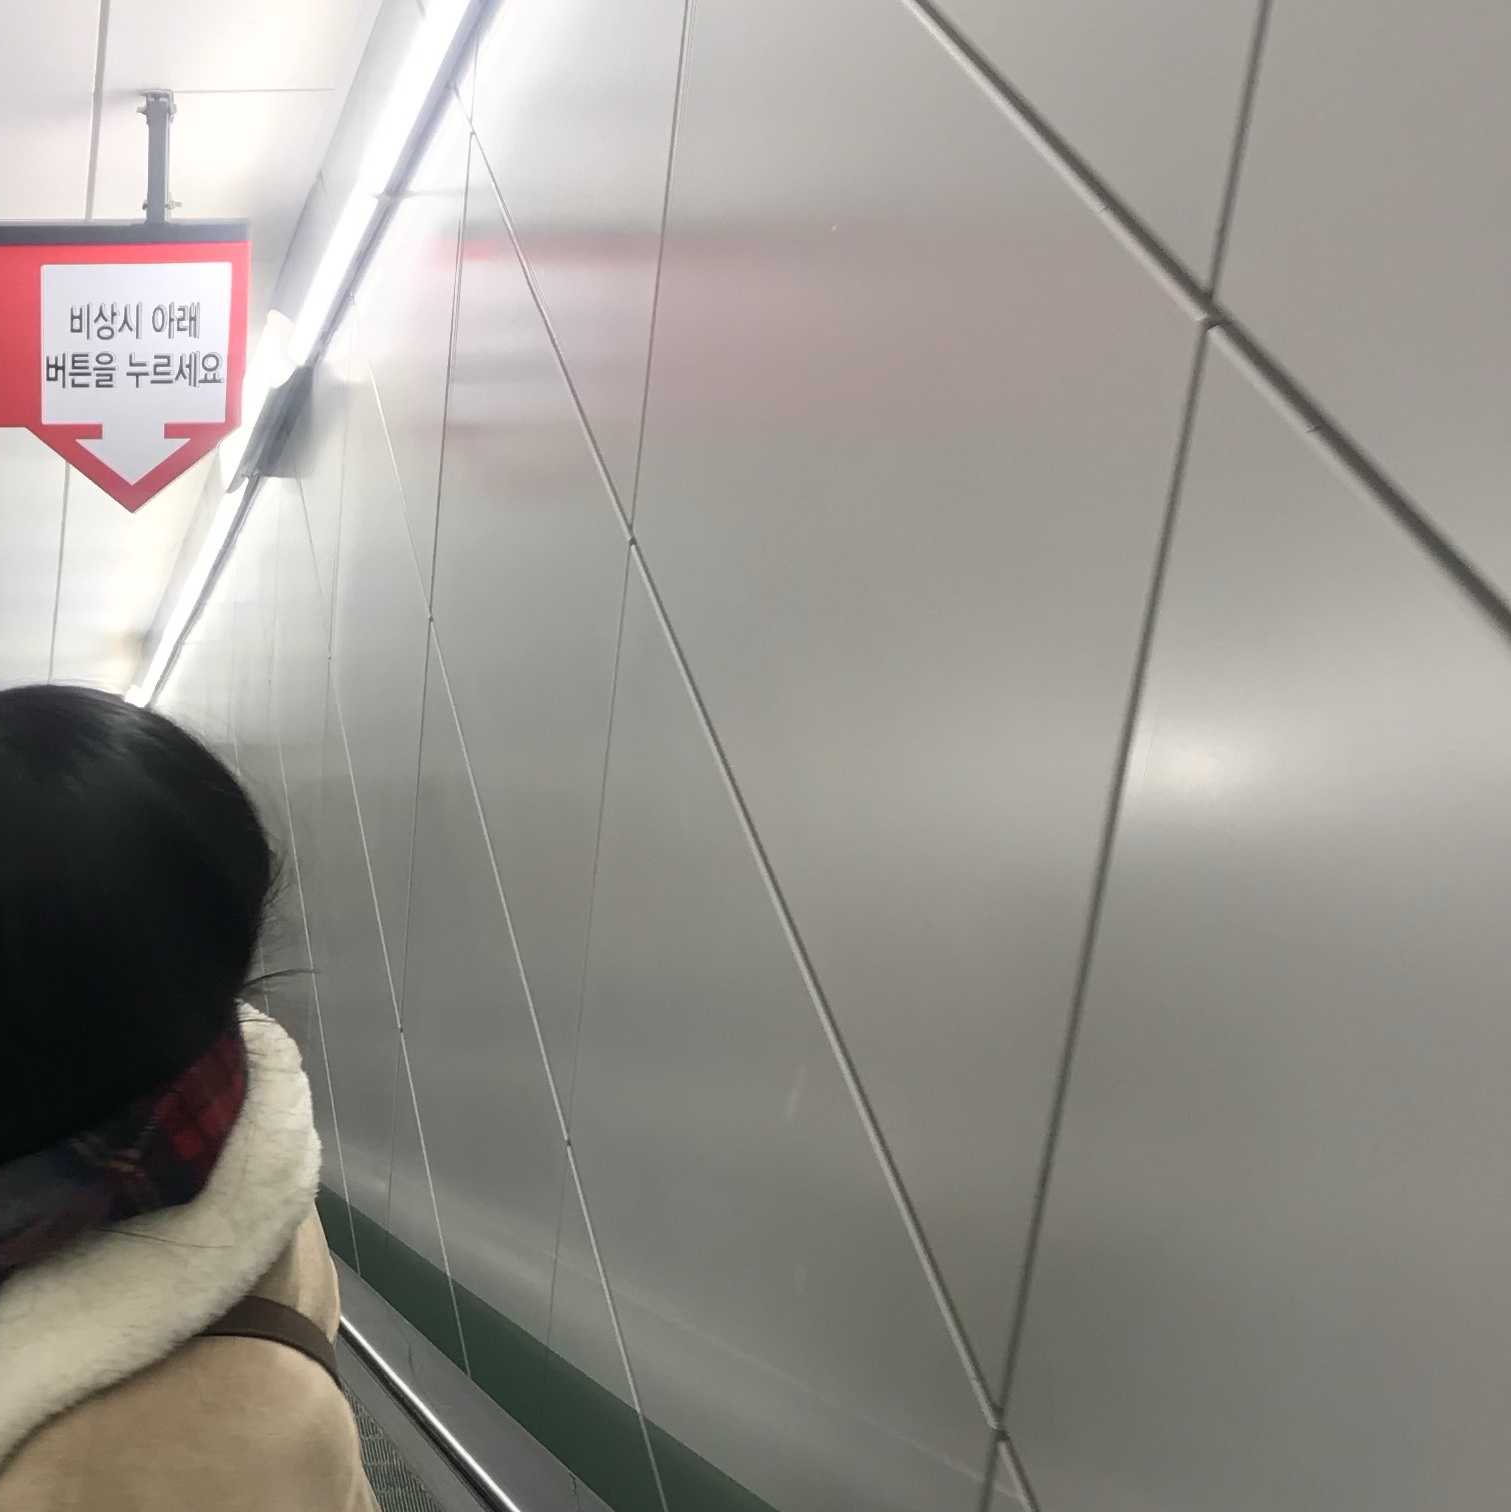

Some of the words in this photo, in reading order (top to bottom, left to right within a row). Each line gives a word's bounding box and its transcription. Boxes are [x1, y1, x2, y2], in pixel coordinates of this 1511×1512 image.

[69, 301, 143, 341] 비상시
[151, 301, 201, 340] 아래
[45, 352, 117, 389] 버튼을
[125, 352, 225, 389] 누르세요
